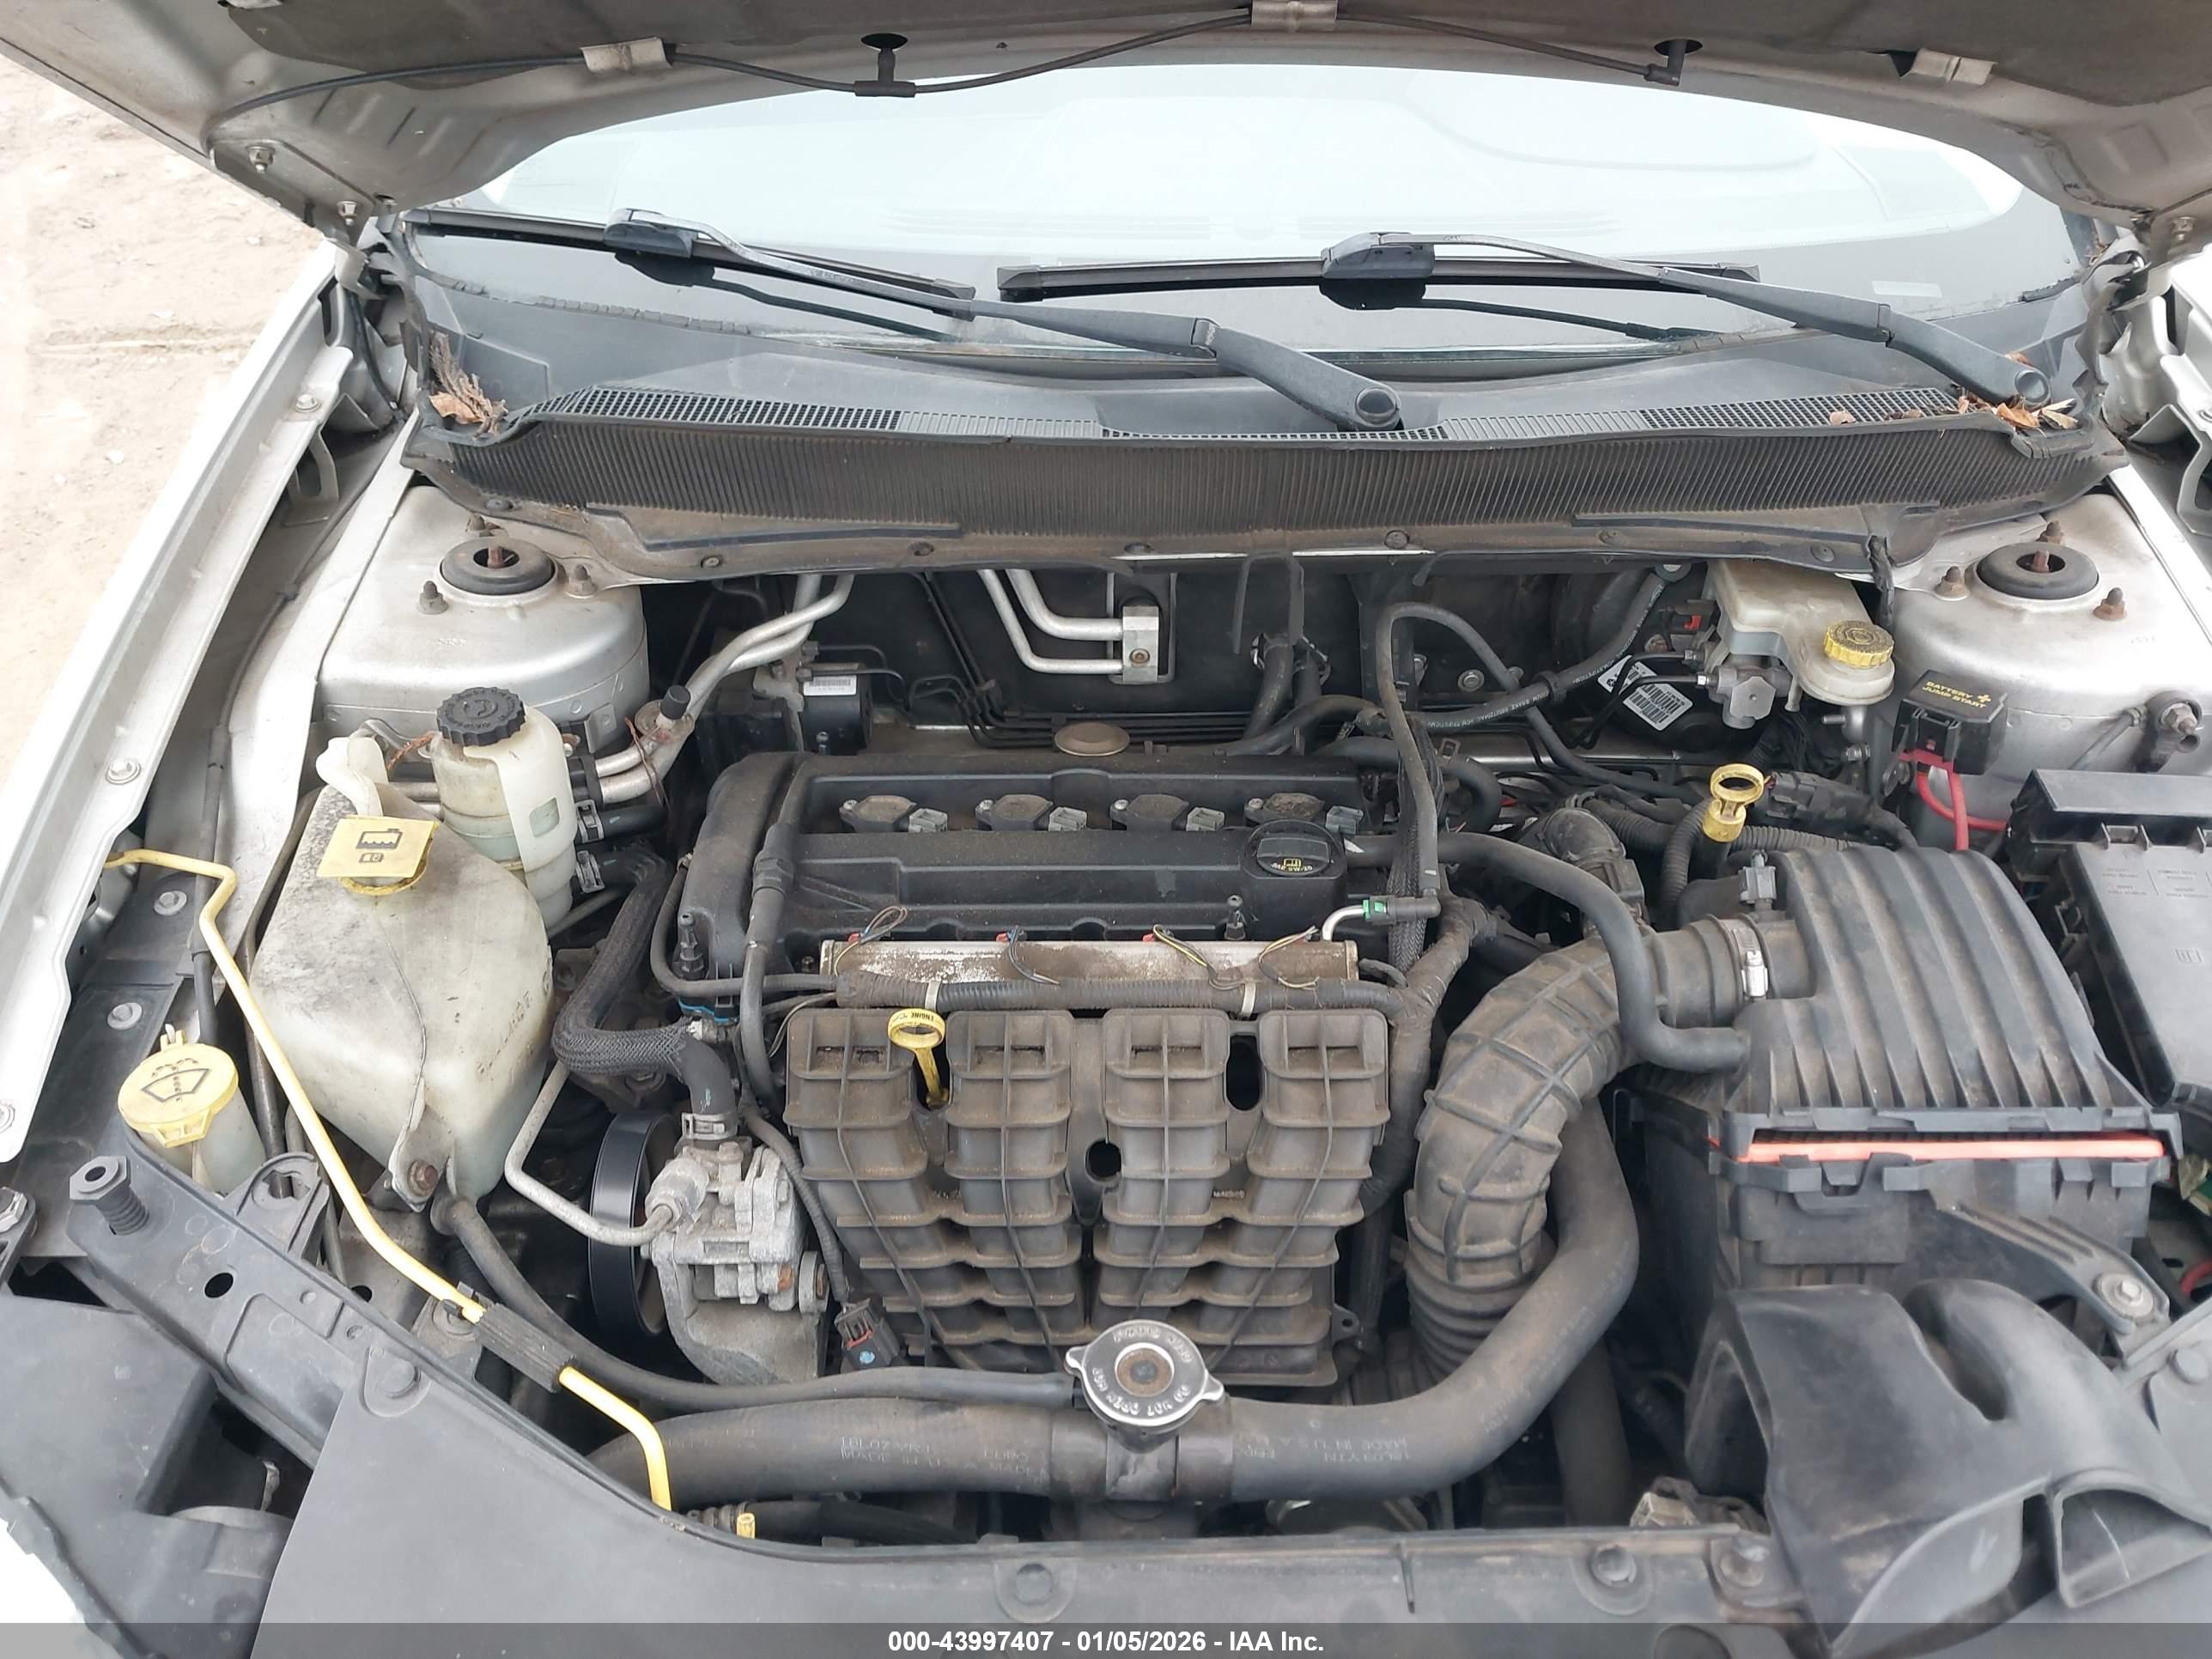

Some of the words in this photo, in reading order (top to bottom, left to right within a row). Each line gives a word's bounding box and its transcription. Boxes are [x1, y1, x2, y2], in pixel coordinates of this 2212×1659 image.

[1922, 686, 1952, 697] JUMP
[1953, 696, 1987, 708] START
[1926, 681, 1973, 698] BATTERY
[910, 1012, 934, 1022] ENGINE
[1173, 1383, 1190, 1403] DO
[1147, 1401, 1174, 1417] NOT
